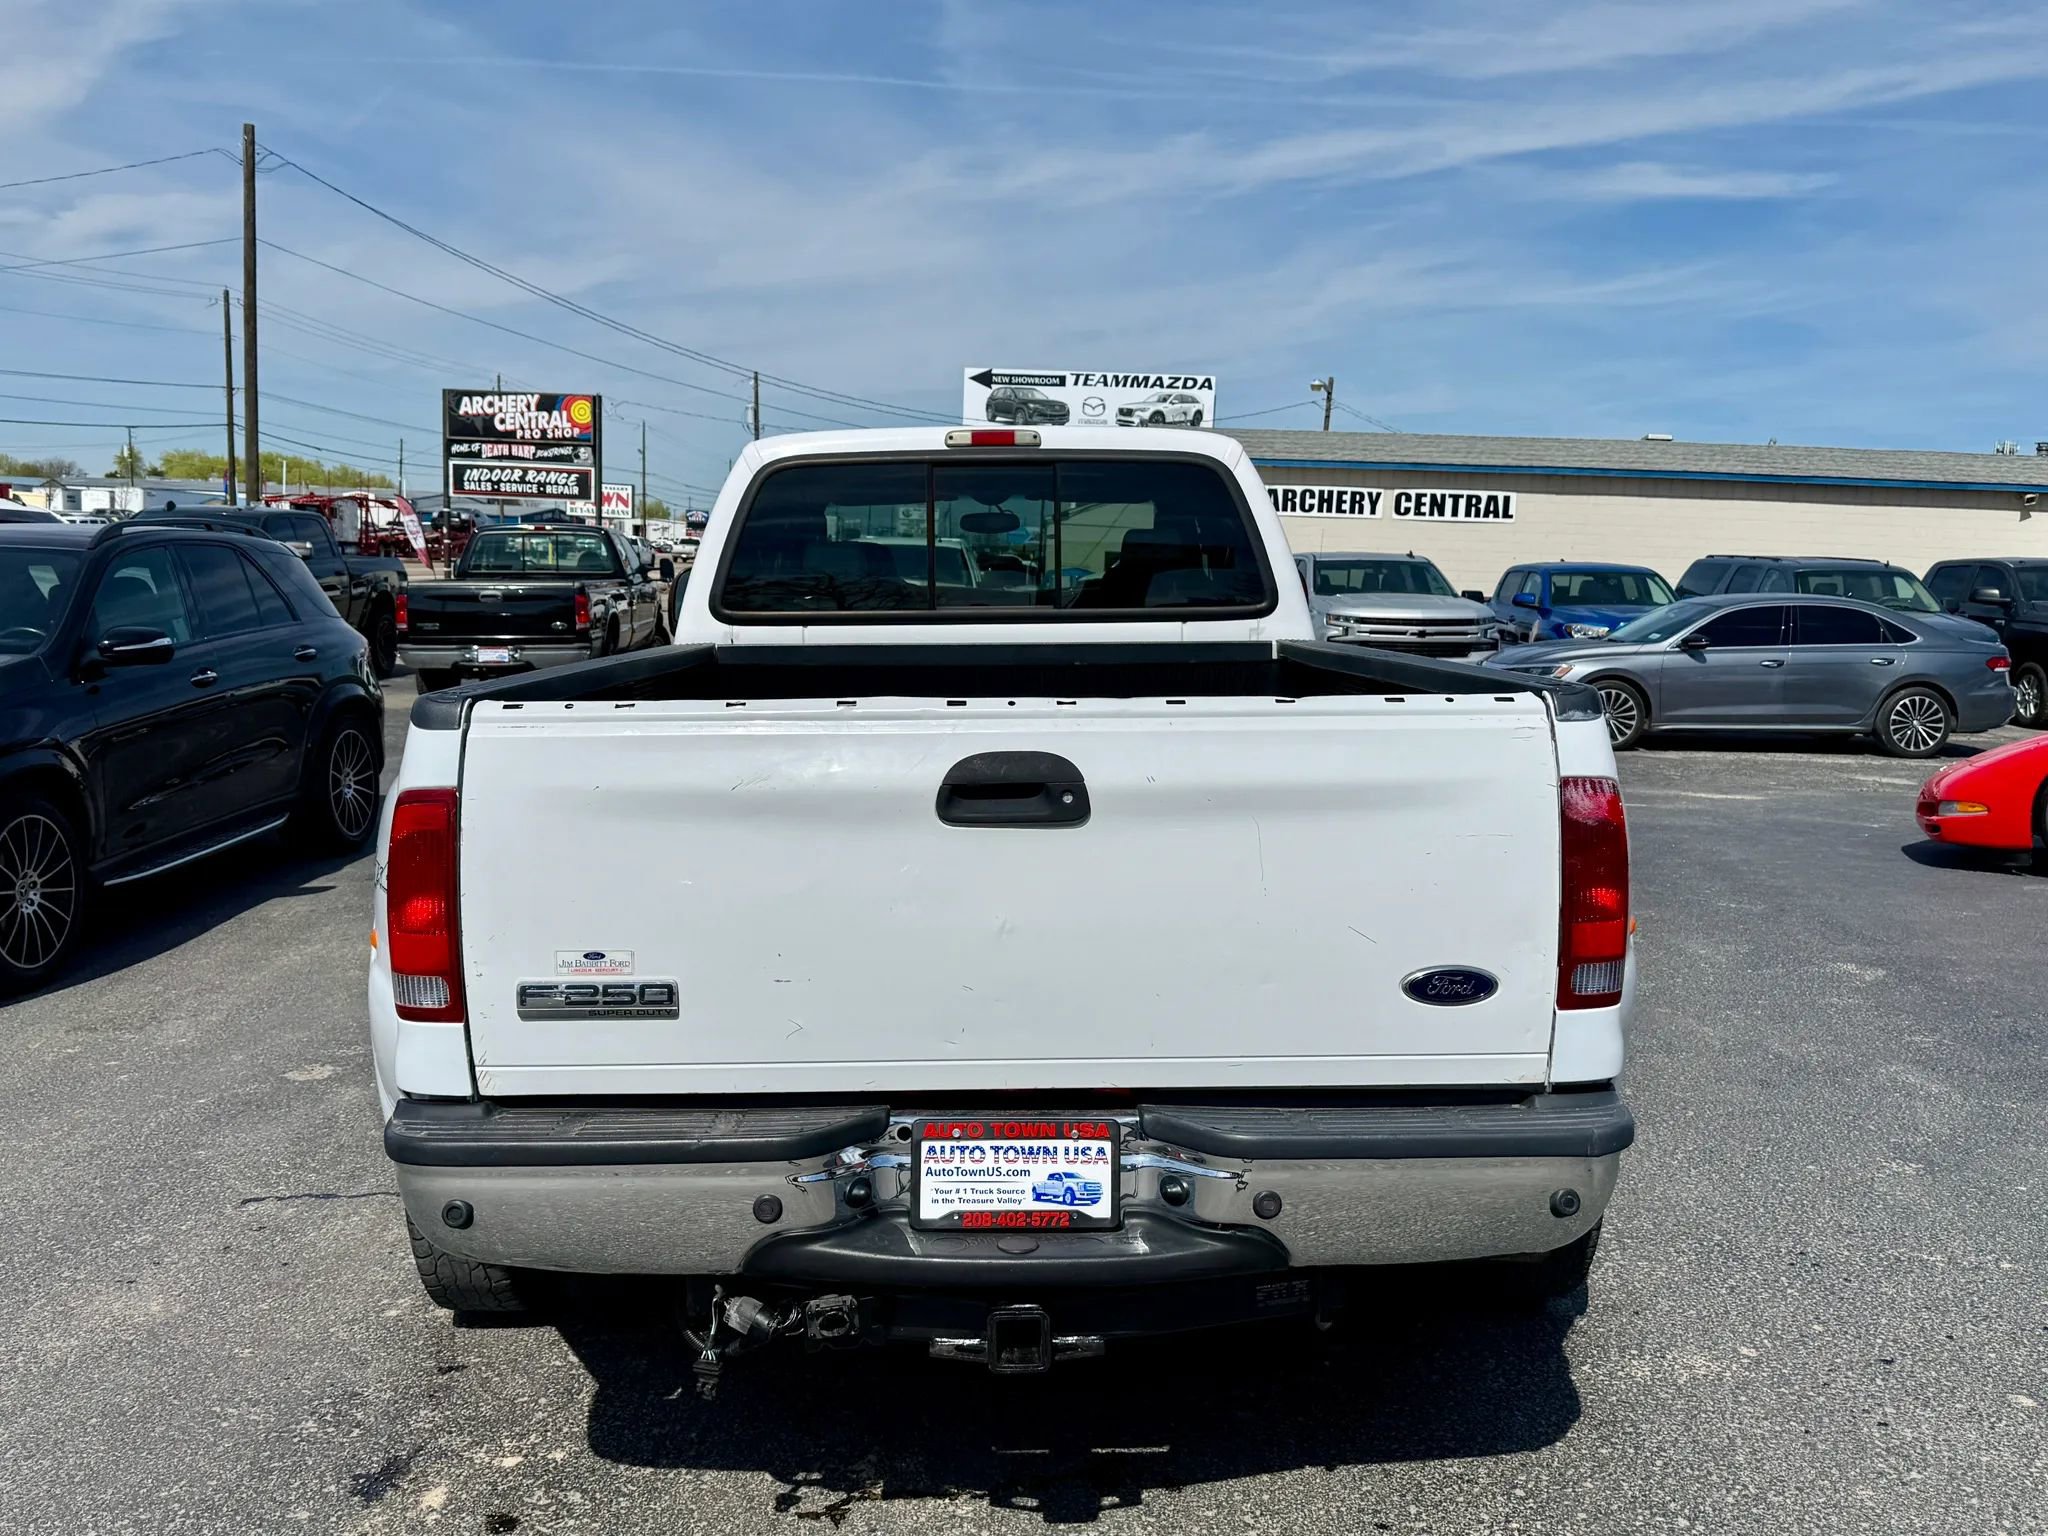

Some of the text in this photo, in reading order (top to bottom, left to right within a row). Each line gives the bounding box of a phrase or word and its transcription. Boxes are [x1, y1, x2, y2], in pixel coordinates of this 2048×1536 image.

[992, 375, 1060, 385] NEW SHOWROOM
[459, 394, 540, 416] ARCHERY
[494, 410, 572, 432] CENTRAL
[516, 427, 580, 439] PRO SHOP
[451, 443, 471, 454] HOME
[471, 442, 481, 453] OF
[481, 443, 509, 459] DEATH
[511, 444, 536, 459] HARP
[463, 468, 579, 486] INDOOR RANGE
[463, 481, 579, 495] SALES SERVICE REPAIR
[1267, 488, 1514, 520] ARCHERY CENTRAL
[558, 959, 573, 968] JIM
[609, 959, 631, 968] FORD
[1427, 975, 1475, 995] Ford
[588, 1009, 673, 1017] SUPER DUTY
[923, 1122, 1110, 1138] AUTO TOWN USA
[924, 1145, 1109, 1165] AUTO TOWN USA
[925, 1166, 1031, 1177] AutoTownUS.com
[955, 1187, 961, 1195] #
[970, 1187, 994, 1195] Truck
[996, 1187, 1026, 1195] Source
[962, 1211, 1070, 1227] 208-402-5772
